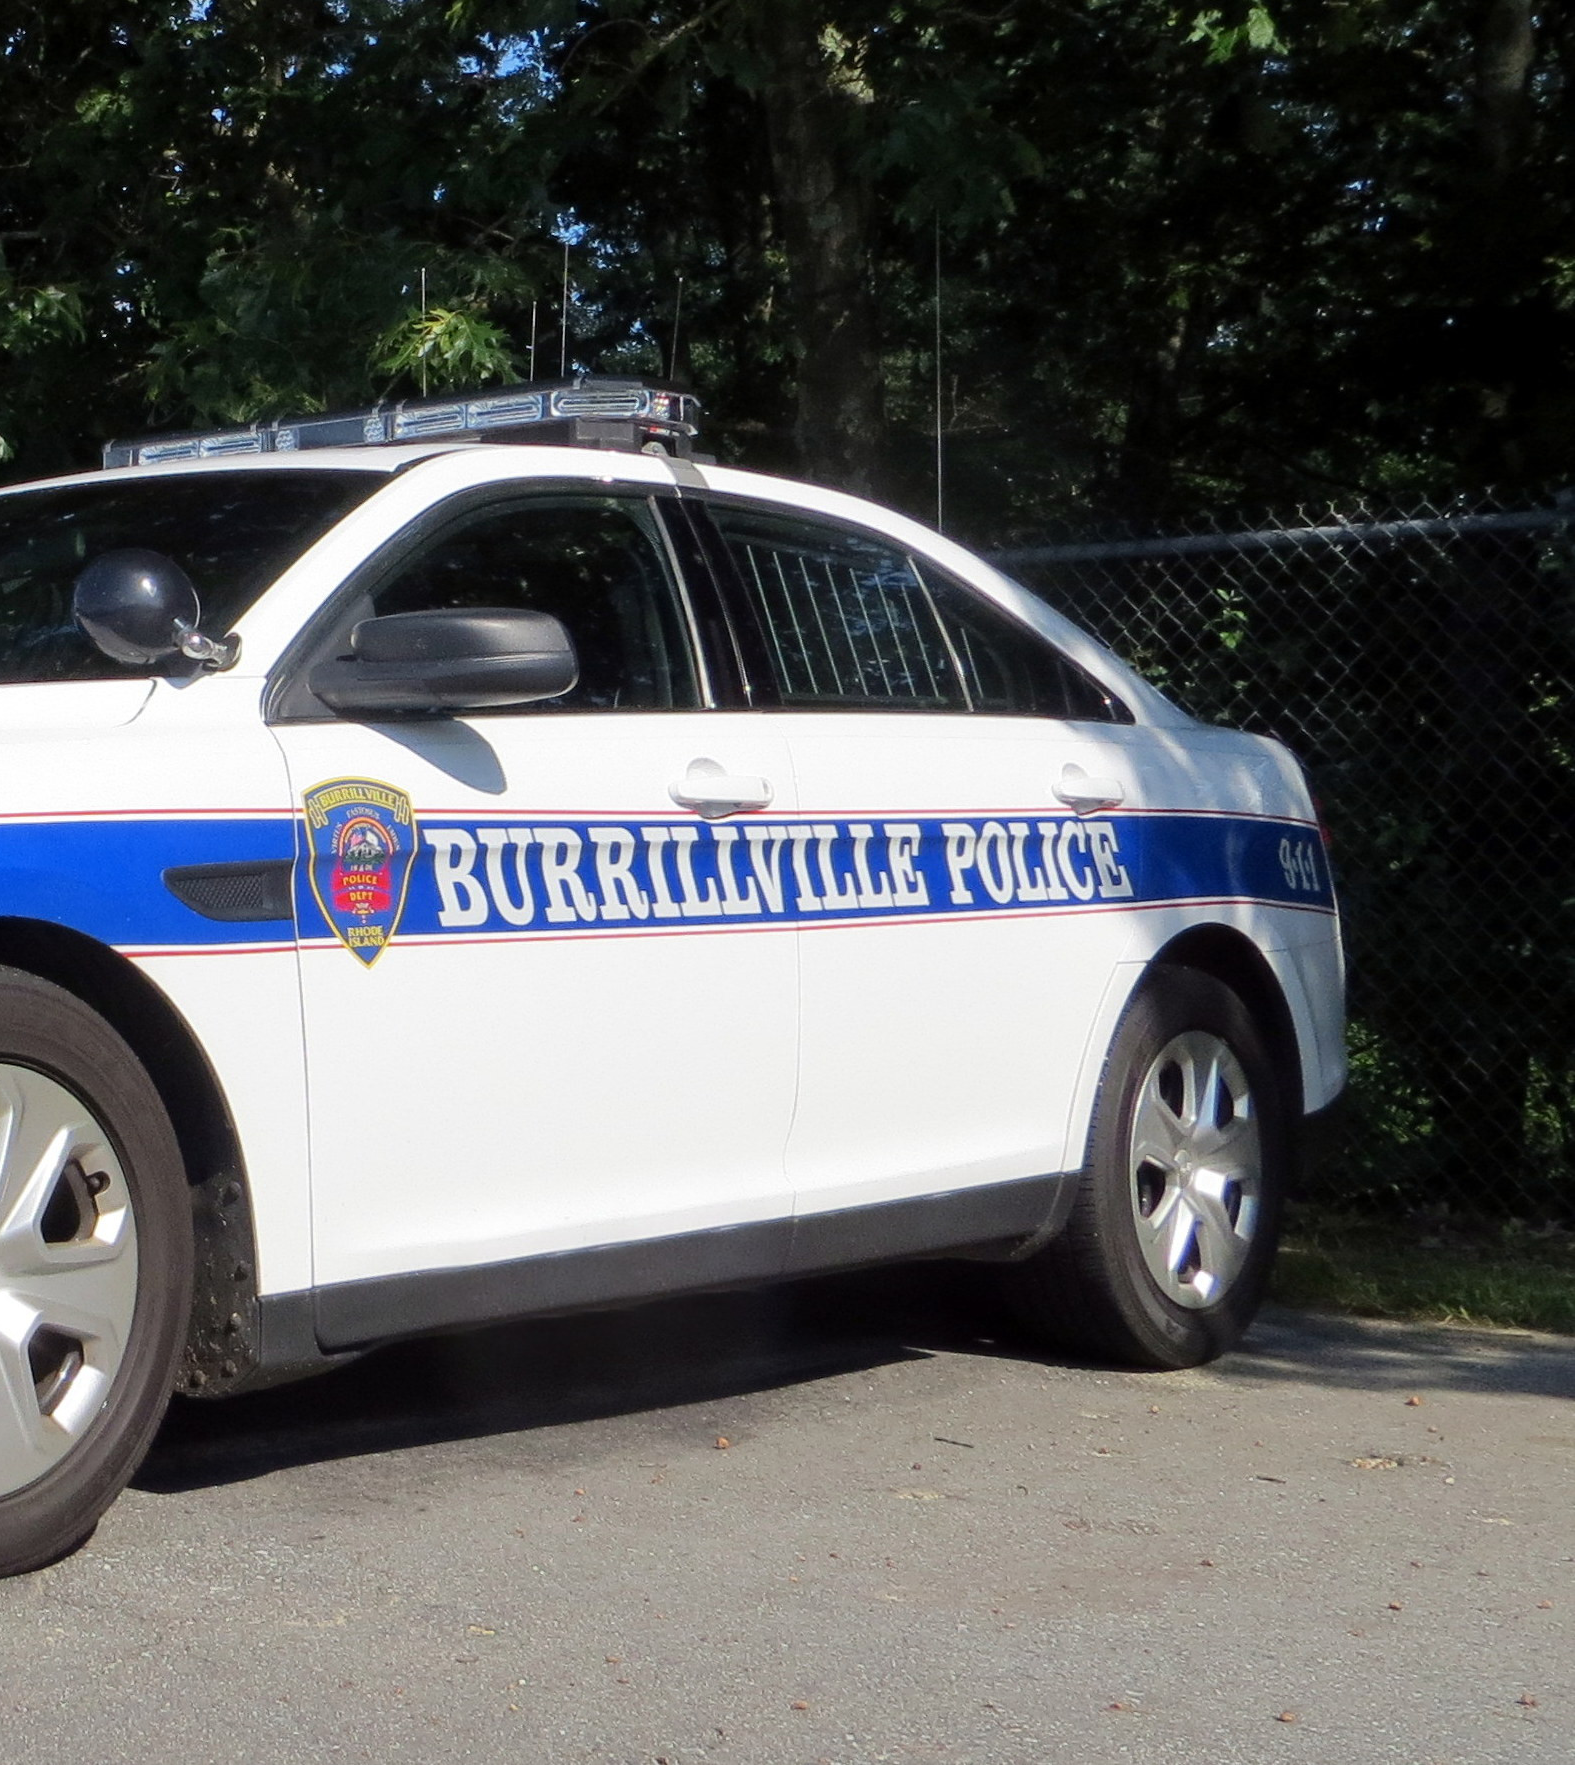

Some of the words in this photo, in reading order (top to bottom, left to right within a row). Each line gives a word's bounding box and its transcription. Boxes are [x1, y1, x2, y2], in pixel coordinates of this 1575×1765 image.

[319, 787, 396, 808] BURRILLVILLE
[342, 874, 379, 886] POLICE
[422, 824, 930, 927] BURRILLVILLE
[941, 821, 1134, 904] POLICE
[349, 891, 373, 902] DEPT
[347, 925, 383, 937] RHODE
[348, 936, 385, 948] ISLAND
